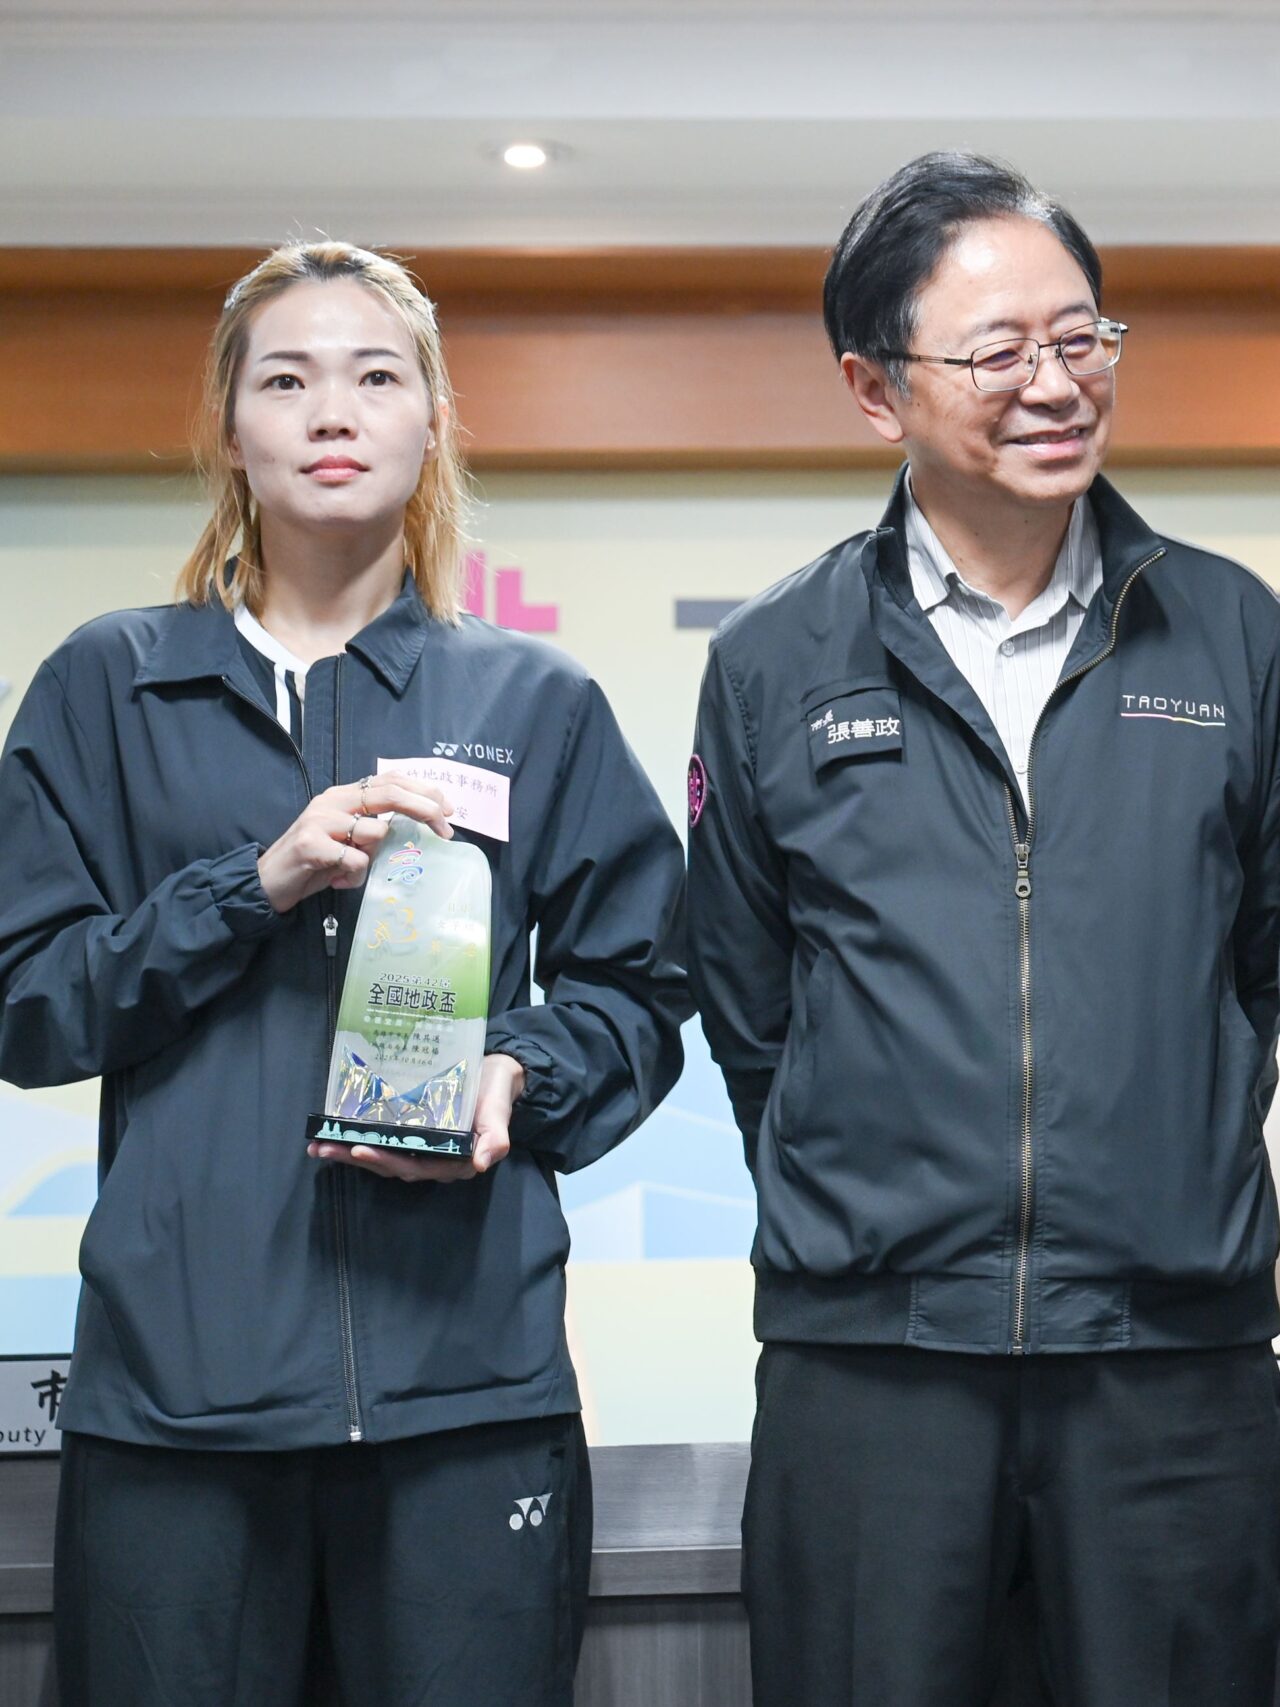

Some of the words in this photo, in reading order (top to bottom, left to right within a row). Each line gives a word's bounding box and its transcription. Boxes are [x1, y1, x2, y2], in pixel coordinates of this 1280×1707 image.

[1121, 694, 1225, 719] TAOYUAN
[827, 716, 901, 745] 張善政
[462, 743, 516, 765] YONEX
[367, 982, 457, 1014] 全國地政盃
